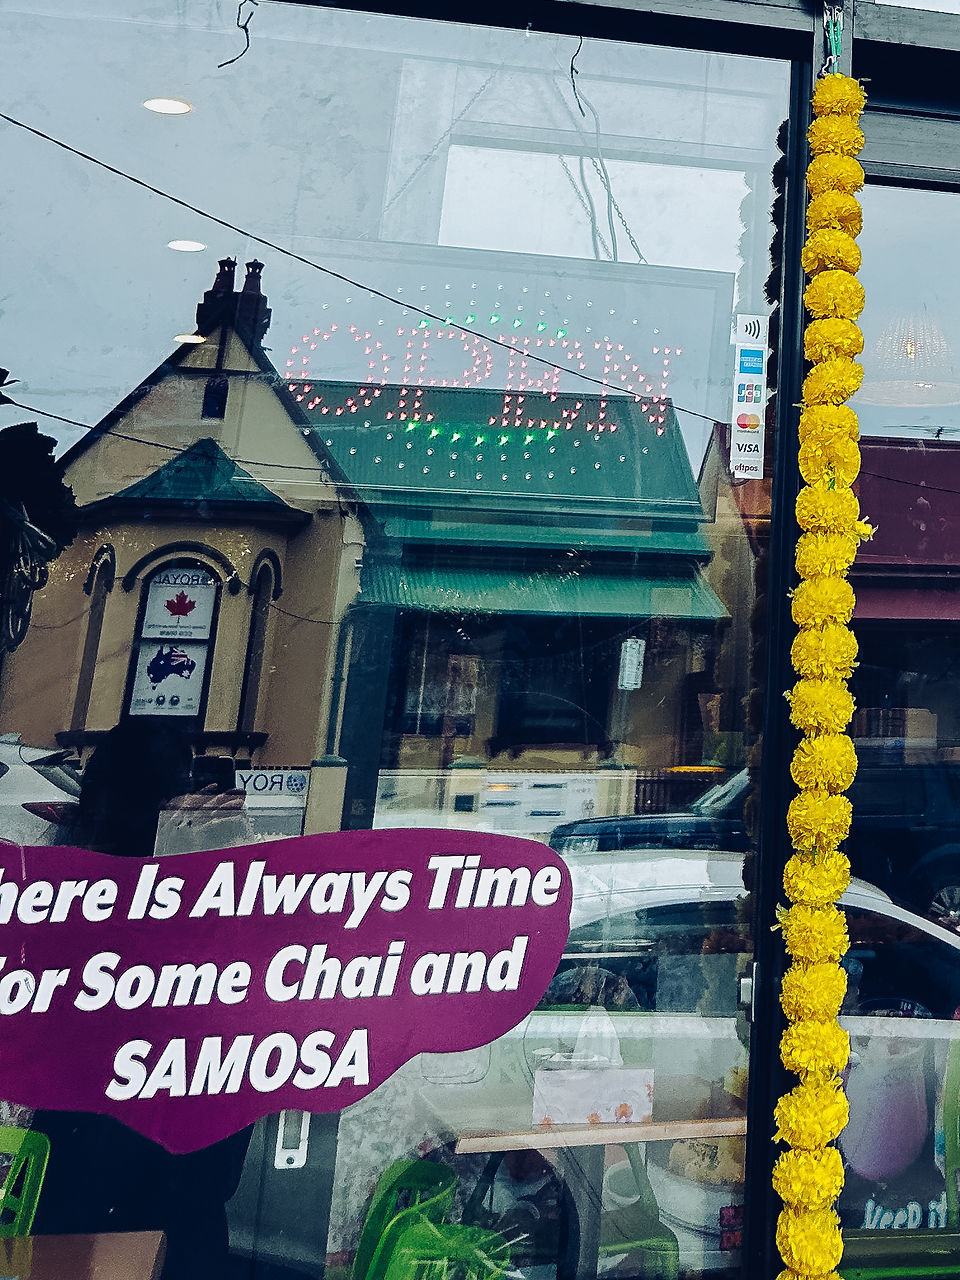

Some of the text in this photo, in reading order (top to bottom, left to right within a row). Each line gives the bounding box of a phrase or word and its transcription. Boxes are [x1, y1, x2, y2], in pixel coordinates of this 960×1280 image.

[734, 463, 758, 472] eftpos
[735, 442, 760, 453] VISA
[126, 863, 184, 920] Is
[190, 860, 413, 930] Always
[425, 855, 563, 912] Time
[0, 935, 530, 1016] or Some Chai and
[104, 1027, 371, 1102] SAMOSA
